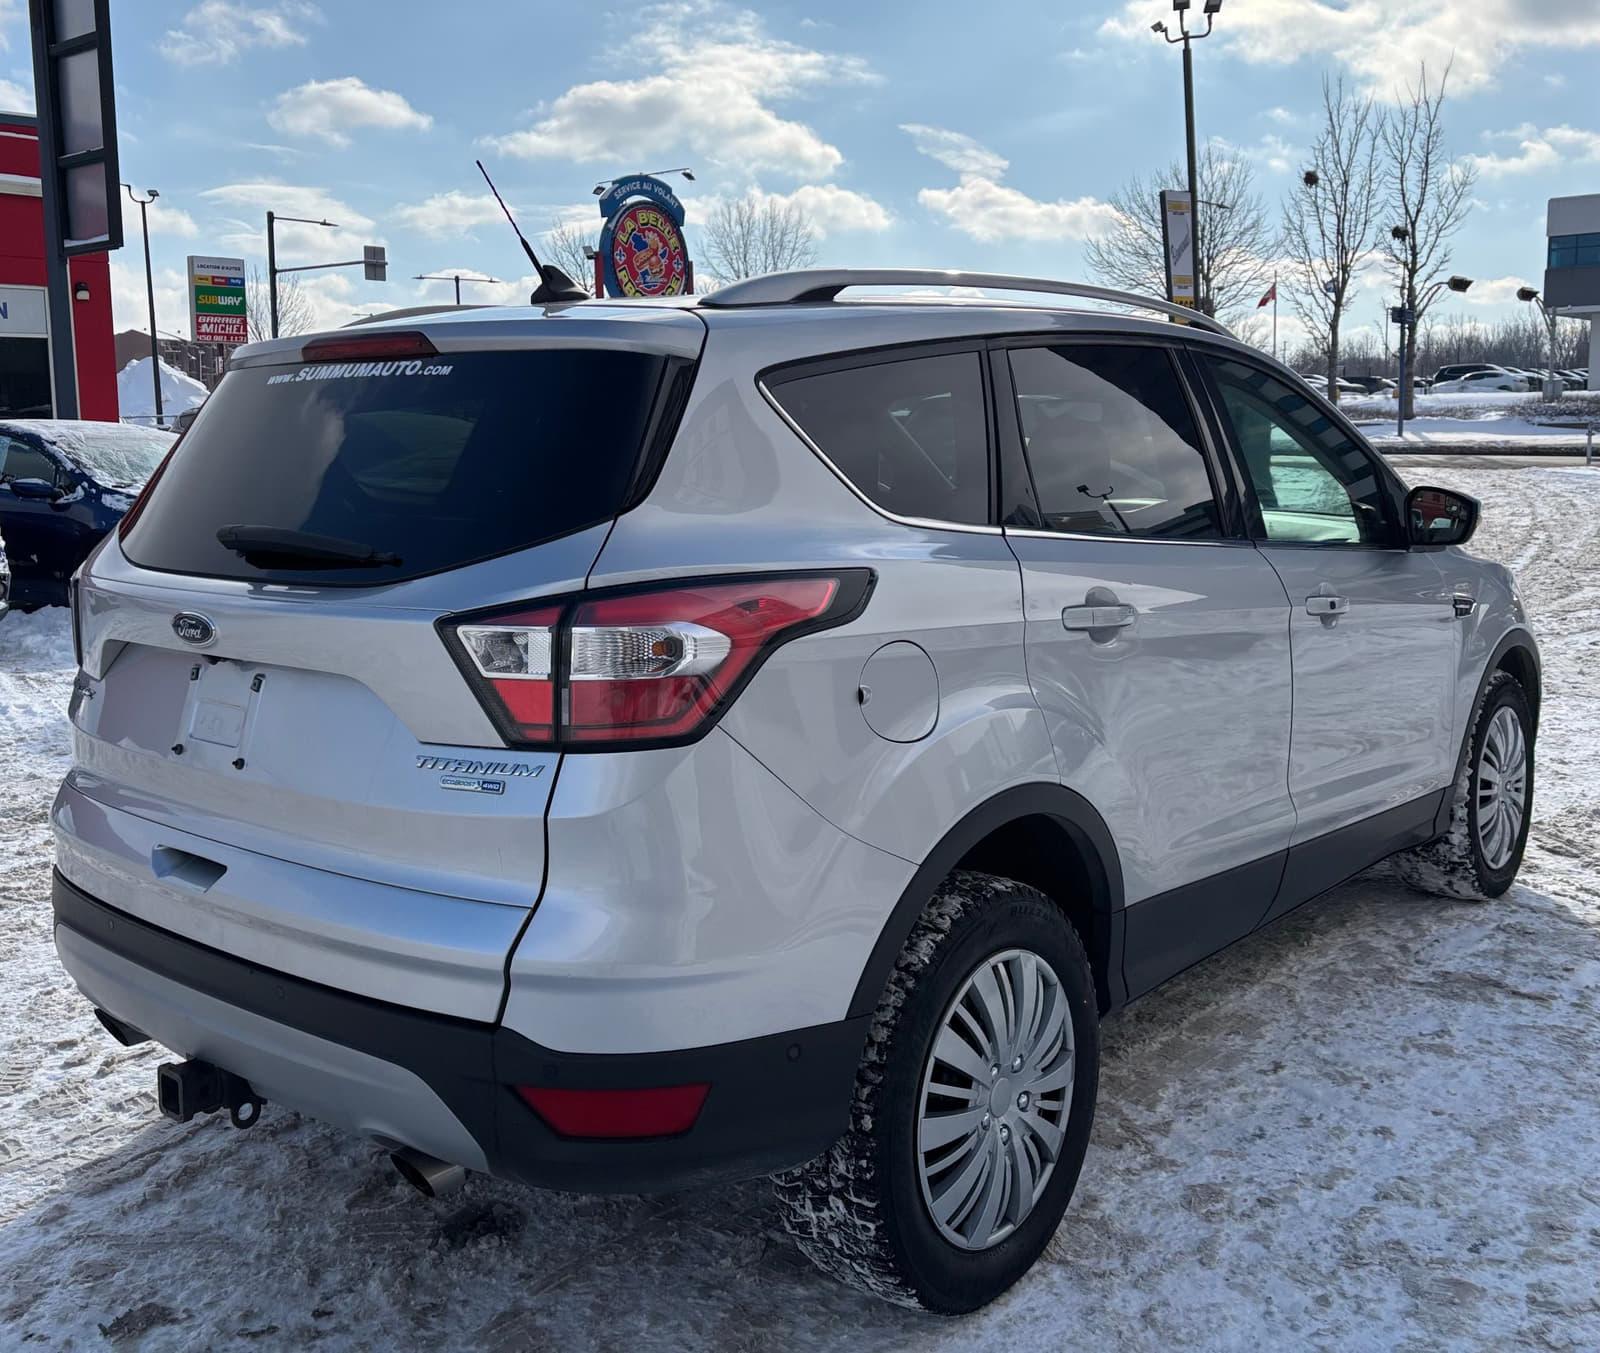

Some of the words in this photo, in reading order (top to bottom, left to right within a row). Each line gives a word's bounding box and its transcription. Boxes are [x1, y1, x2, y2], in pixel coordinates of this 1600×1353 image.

[614, 181, 641, 199] SERVICE
[642, 182, 652, 190] AU
[654, 184, 679, 208] VOLANT
[617, 217, 637, 246] LA
[637, 210, 680, 253] BELLE
[198, 294, 243, 306] SUBWAY
[198, 315, 244, 324] GARAGE
[200, 323, 246, 335] MICHEL
[178, 618, 203, 639] Ford
[416, 755, 545, 777] TITANIUM
[482, 782, 500, 790] 4WD
